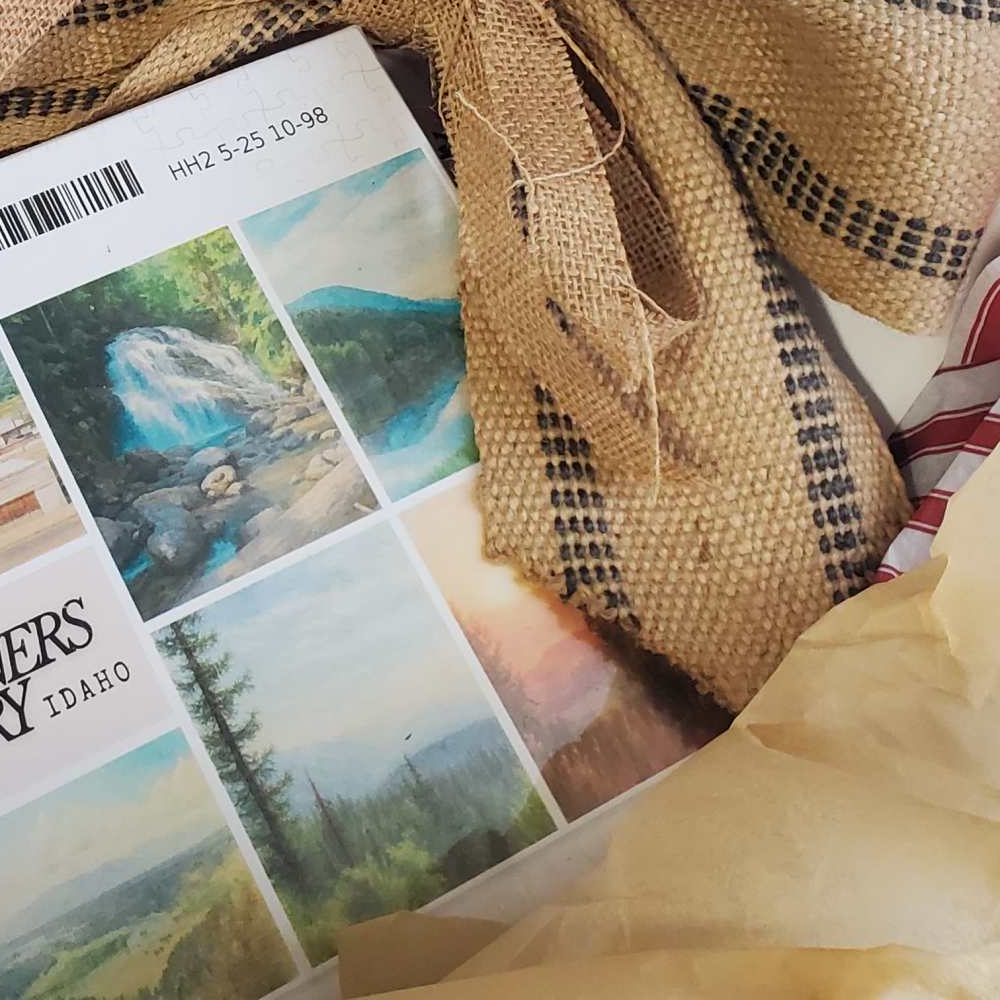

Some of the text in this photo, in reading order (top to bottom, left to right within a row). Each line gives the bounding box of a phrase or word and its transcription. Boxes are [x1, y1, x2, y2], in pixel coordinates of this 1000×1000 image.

[168, 106, 328, 181] HH2 5-25 10-98
[42, 660, 131, 718] IDAHO
